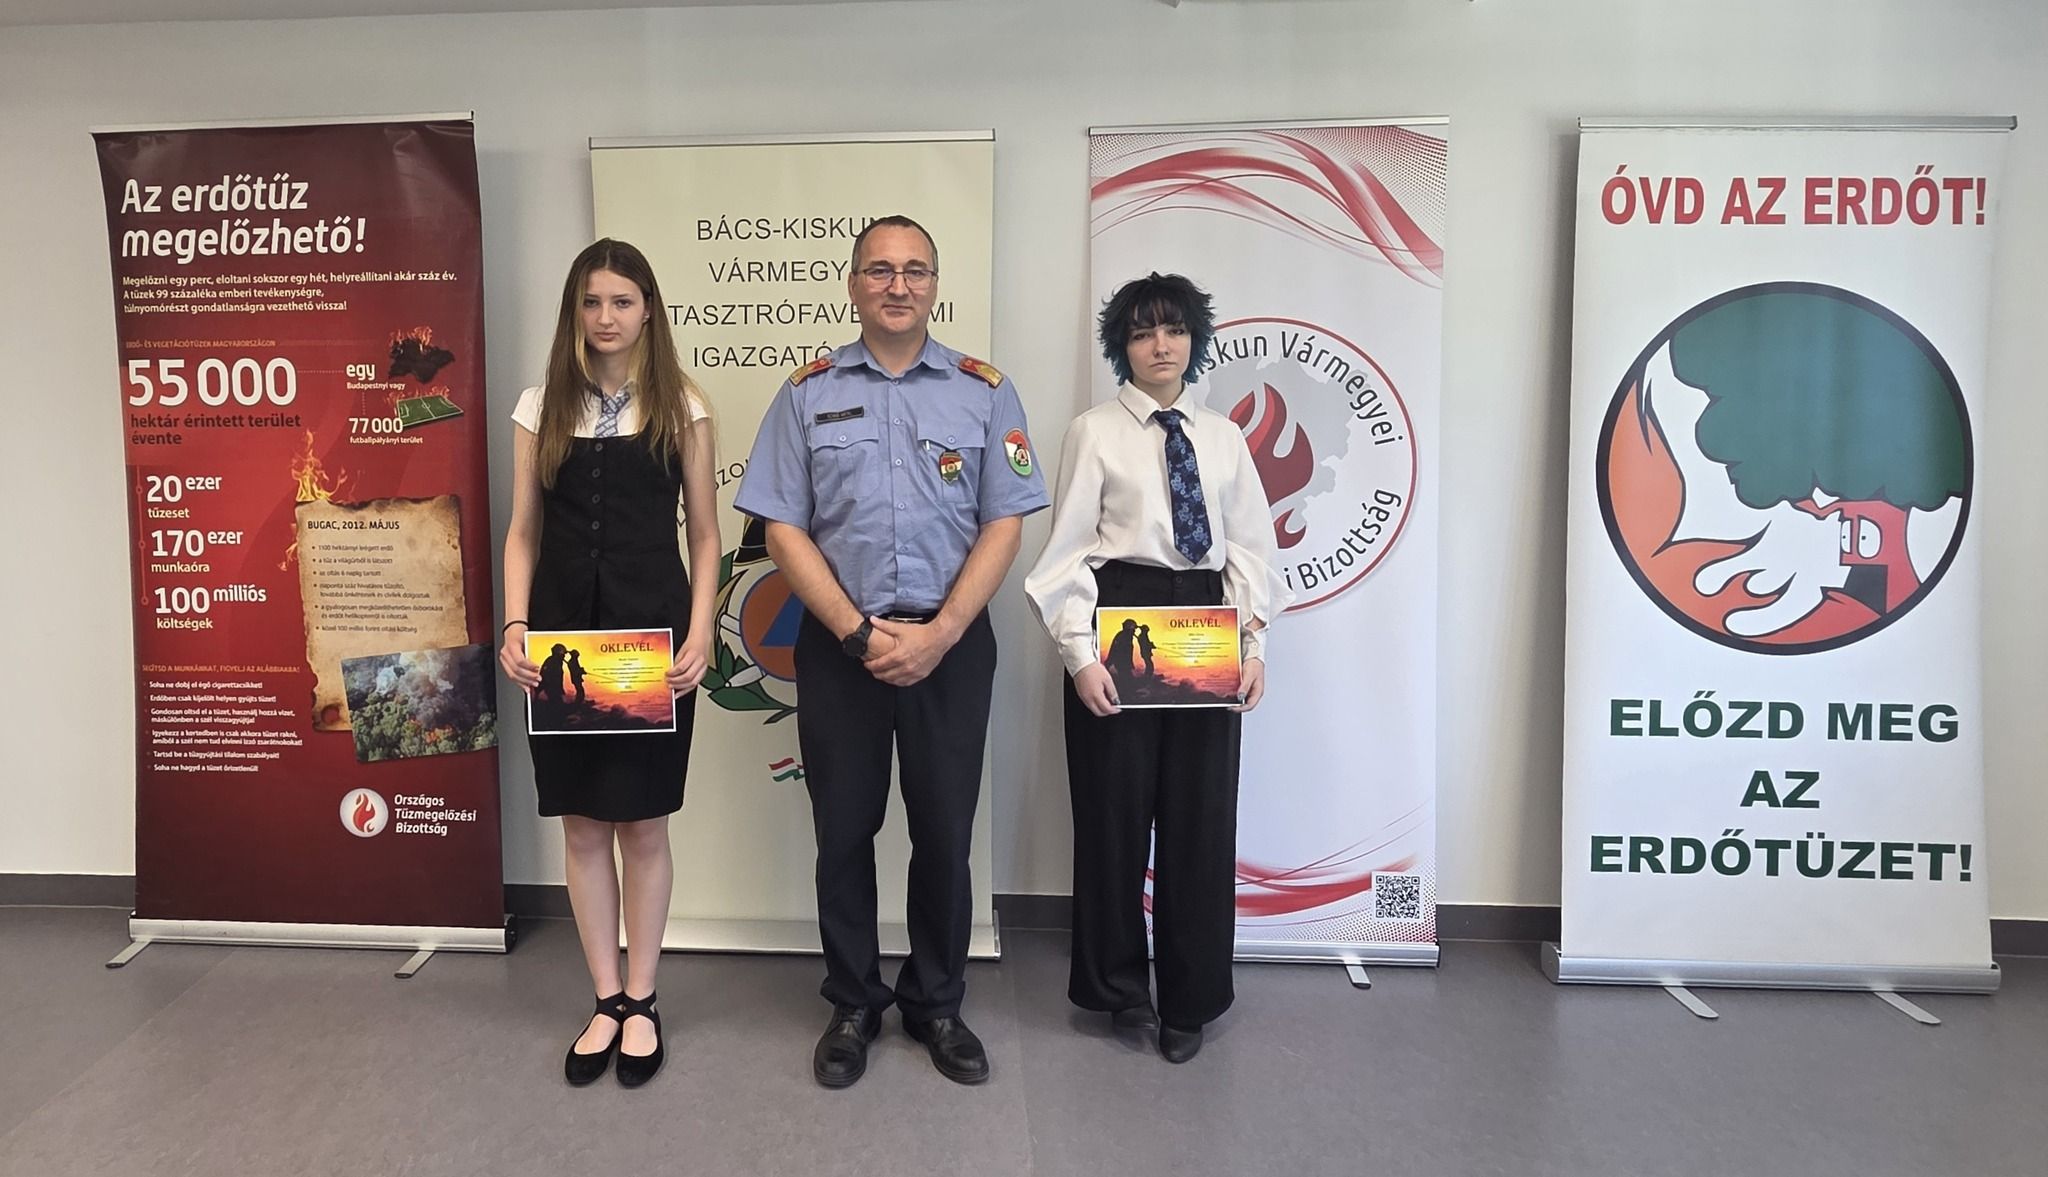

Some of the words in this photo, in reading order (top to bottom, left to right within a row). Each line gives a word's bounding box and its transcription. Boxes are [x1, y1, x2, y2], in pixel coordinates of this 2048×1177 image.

[120, 179, 162, 214] Az
[171, 174, 309, 212] erdőtűz
[1601, 165, 1705, 225] ÓVD
[1720, 177, 1787, 225] AZ
[1804, 165, 1987, 225] ERDŐT!
[697, 215, 875, 241] BÁCS-KISKU
[122, 217, 366, 264] megelőzhető!
[122, 275, 168, 288] Megelőzni
[169, 277, 188, 287] egy
[190, 277, 214, 287] perc,
[215, 274, 252, 284] eloltani
[252, 273, 289, 284] sokszor
[290, 275, 308, 285] egy
[309, 272, 329, 284] hét,
[330, 271, 393, 284] helyreállítani
[393, 271, 417, 281] akár
[418, 271, 441, 281] száz
[442, 270, 457, 281] év.
[709, 257, 848, 283] VÁRMEGY
[124, 290, 130, 300] A
[130, 289, 155, 299] tüzek
[157, 289, 169, 299] 99
[170, 288, 217, 299] százaléka
[218, 288, 252, 298] emberi
[253, 287, 325, 299] tevékenységre,
[124, 303, 190, 315] túlnyomórészt
[190, 302, 266, 315] gondatlanságra
[266, 301, 314, 311] vezethető
[315, 300, 347, 311] vissza!
[693, 341, 833, 367] IGAZGATÓ
[346, 363, 377, 382] egy
[1281, 331, 1403, 445] Vármegyei
[130, 413, 180, 428] hektár
[183, 413, 245, 428] érintett
[247, 413, 301, 428] terület
[131, 432, 183, 445] évente
[146, 475, 183, 503] 20
[185, 476, 222, 490] ezer
[147, 507, 190, 519] tűzeset
[307, 520, 341, 531] BUGAC,
[342, 520, 368, 530] 2012.
[369, 519, 400, 530] MÁJUS
[151, 530, 205, 557] 170
[207, 530, 243, 545] ezer
[1297, 488, 1402, 590] Bizottság
[151, 561, 210, 573] munkaóra
[154, 587, 210, 614] 100
[213, 584, 267, 602] milliós
[156, 617, 214, 631] költségek
[1169, 615, 1221, 628] OKLEVÉL
[600, 641, 654, 653] OKLEVÉL
[1610, 691, 1804, 739] ELŐZD
[1827, 703, 1959, 742] MEG
[1740, 770, 1820, 809] AZ
[394, 794, 446, 808] Országos
[394, 808, 477, 822] Tűzmegelőzési
[395, 822, 448, 837] Bizottság
[1590, 829, 1973, 882] ERDŐTÜZET!
